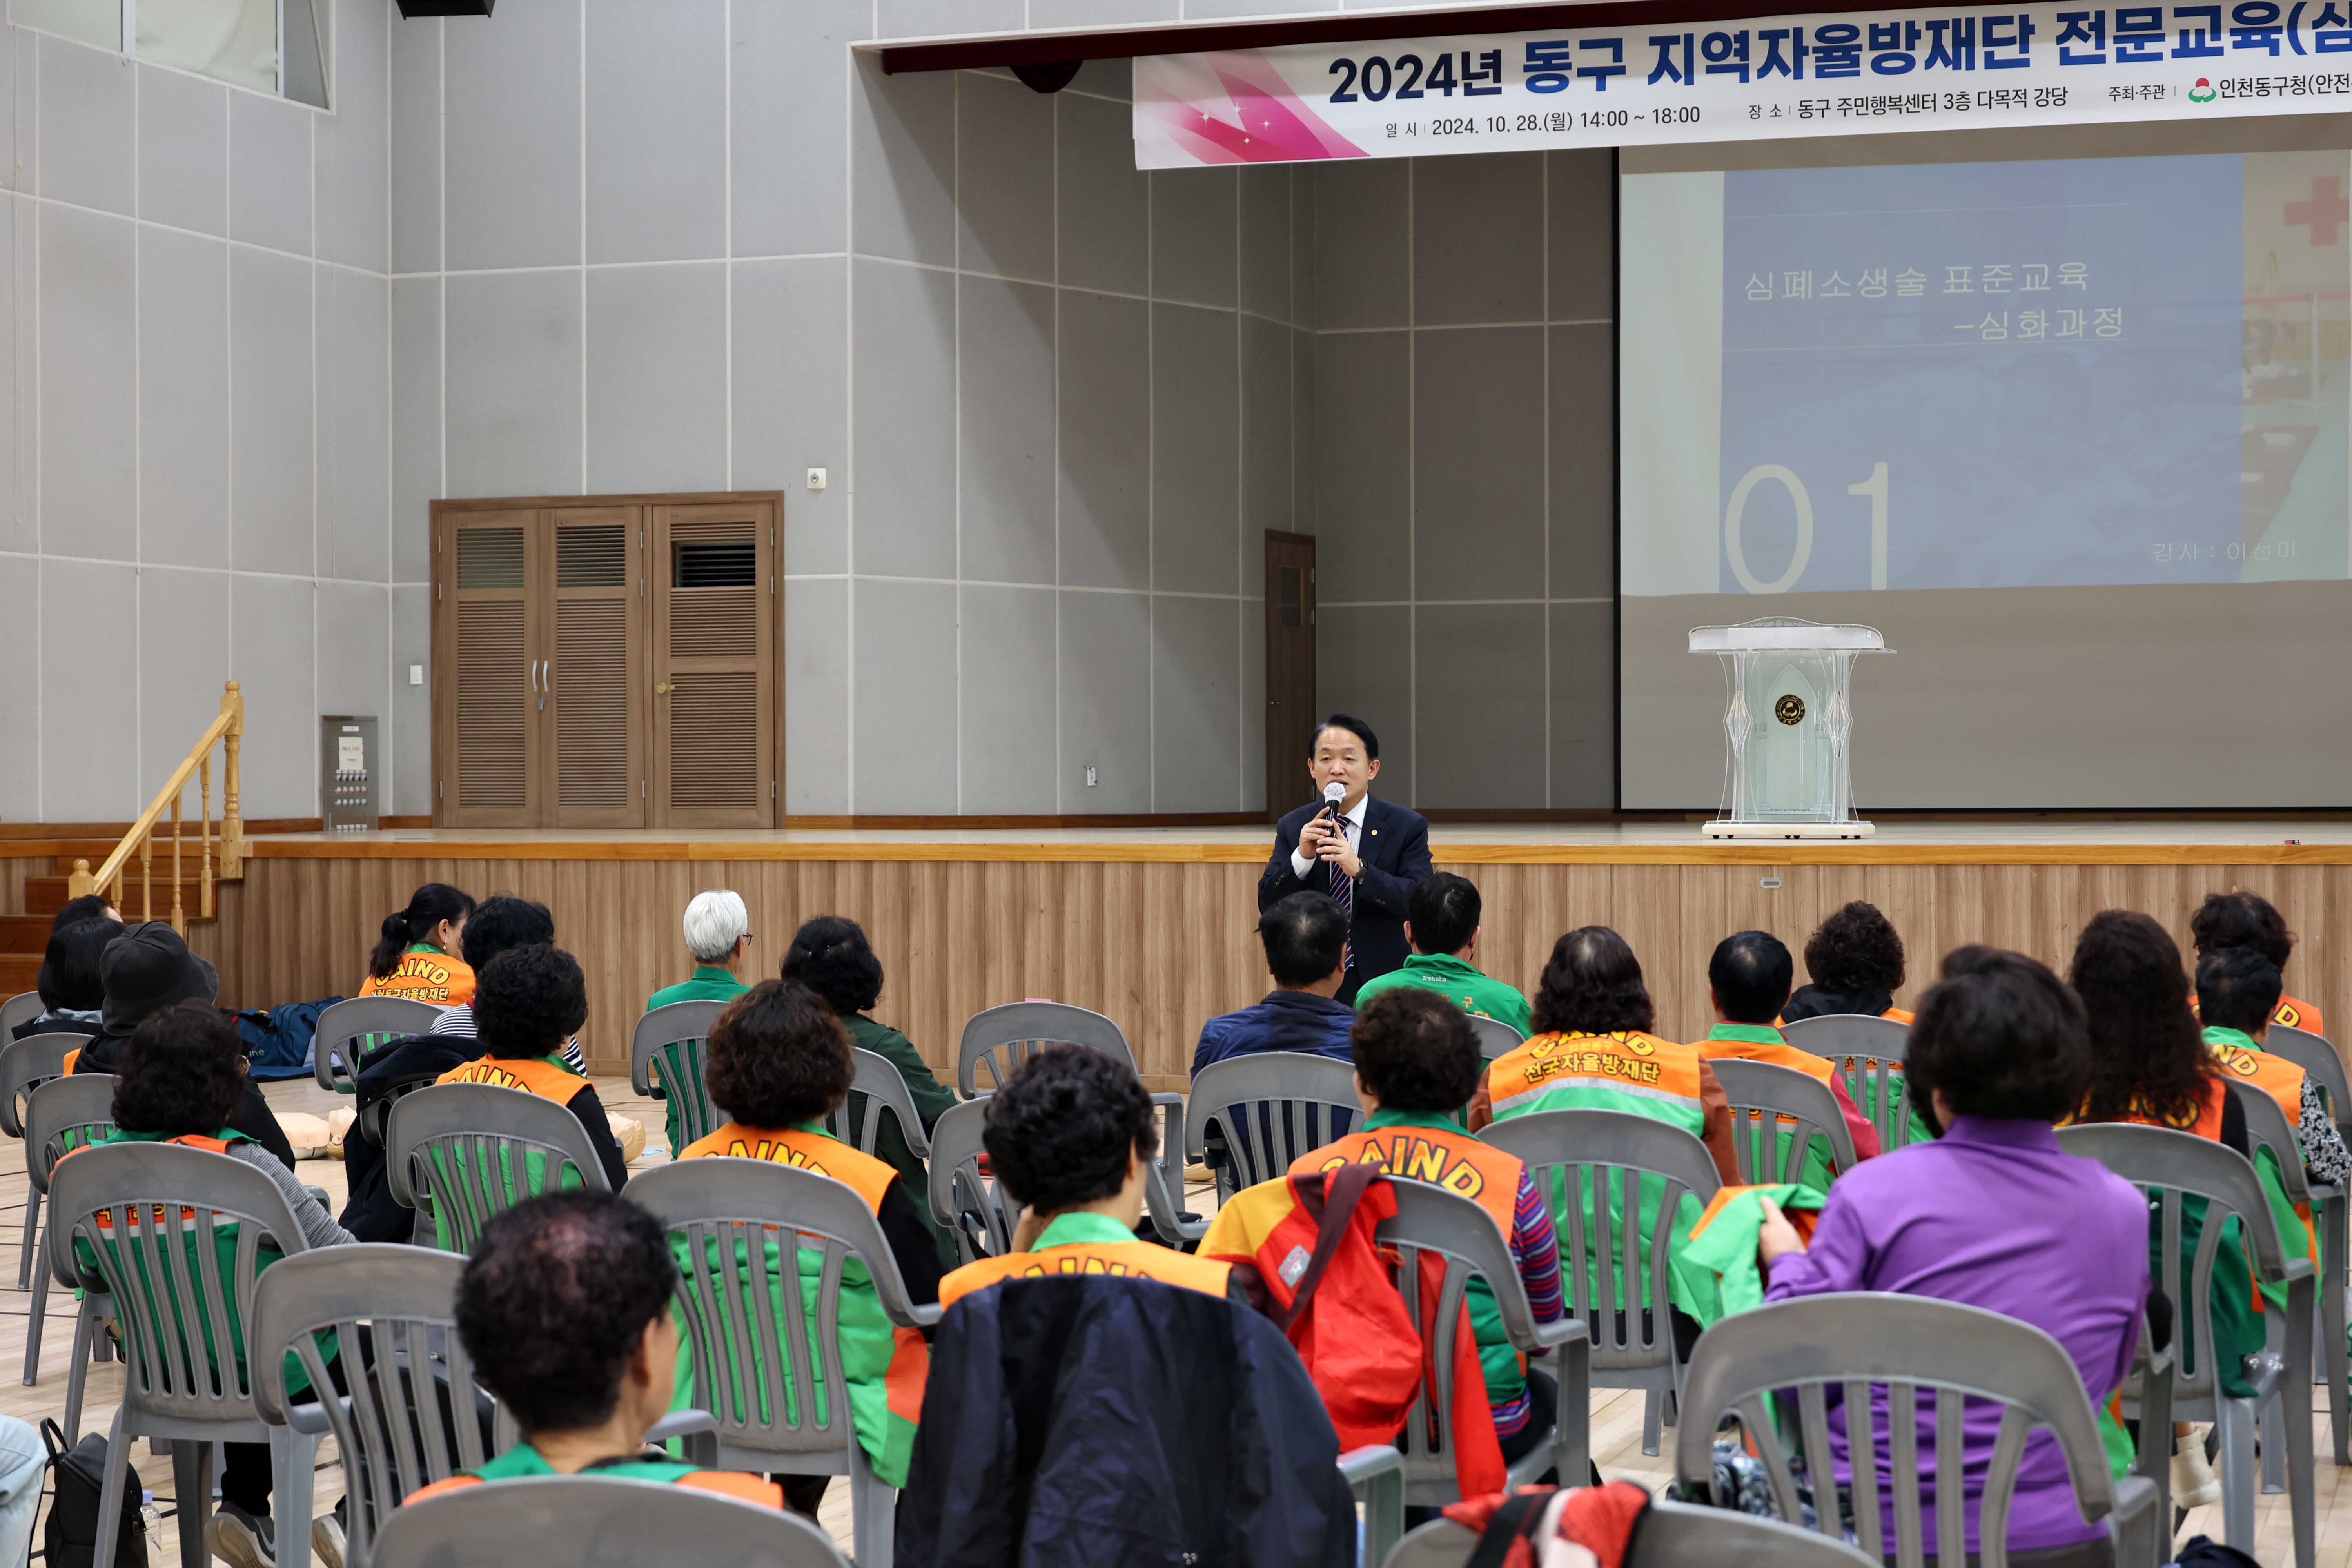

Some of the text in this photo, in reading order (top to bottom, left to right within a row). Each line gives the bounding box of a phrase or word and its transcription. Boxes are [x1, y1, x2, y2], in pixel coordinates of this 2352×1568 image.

[1328, 49, 1502, 103] 2024년
[1523, 37, 1626, 94] 동구
[1648, 14, 2035, 86] 지역자율방재단
[1798, 99, 1831, 118] 동구
[1837, 92, 1937, 116] 주민행복센터
[1943, 91, 1972, 112] 3층
[1977, 88, 2027, 110] 다목적
[2034, 86, 2069, 107] 강당
[1432, 118, 1479, 135] 2024.
[1487, 117, 1510, 132] 10.
[1517, 112, 1573, 132] 28.(월)
[1581, 110, 1628, 128] 14:00
[1651, 106, 1700, 124] 18:00
[1744, 262, 2089, 300] 심폐소생술 표준교육
[1954, 307, 2122, 340] -심화과정
[1725, 461, 1889, 595] 01
[2154, 543, 2199, 562] 강사
[2227, 540, 2296, 561] 이선미
[1524, 1052, 1660, 1084] 전국자율방재단
